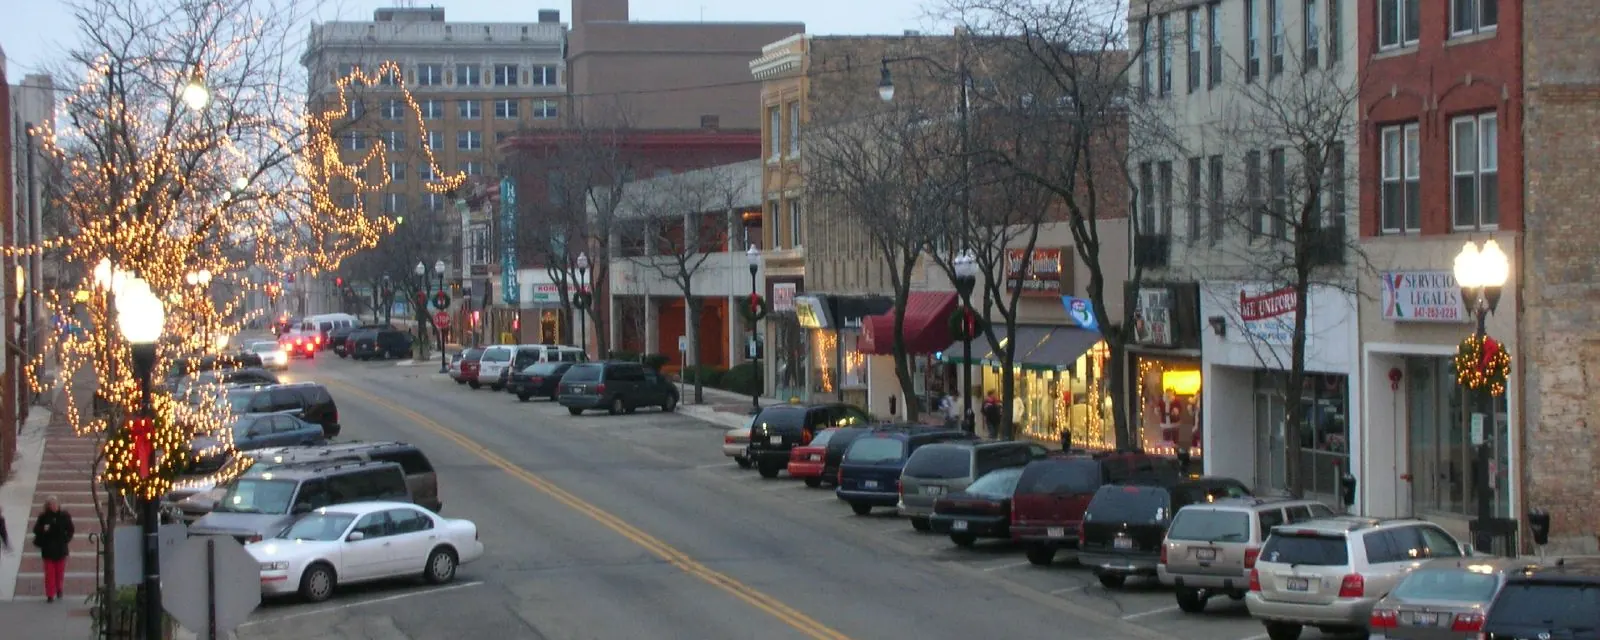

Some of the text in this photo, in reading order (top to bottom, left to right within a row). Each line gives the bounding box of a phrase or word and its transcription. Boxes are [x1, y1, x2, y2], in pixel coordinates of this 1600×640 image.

[1405, 274, 1456, 289] SERVICIO
[1410, 291, 1457, 305] LEGALES
[433, 316, 450, 324] STOP
